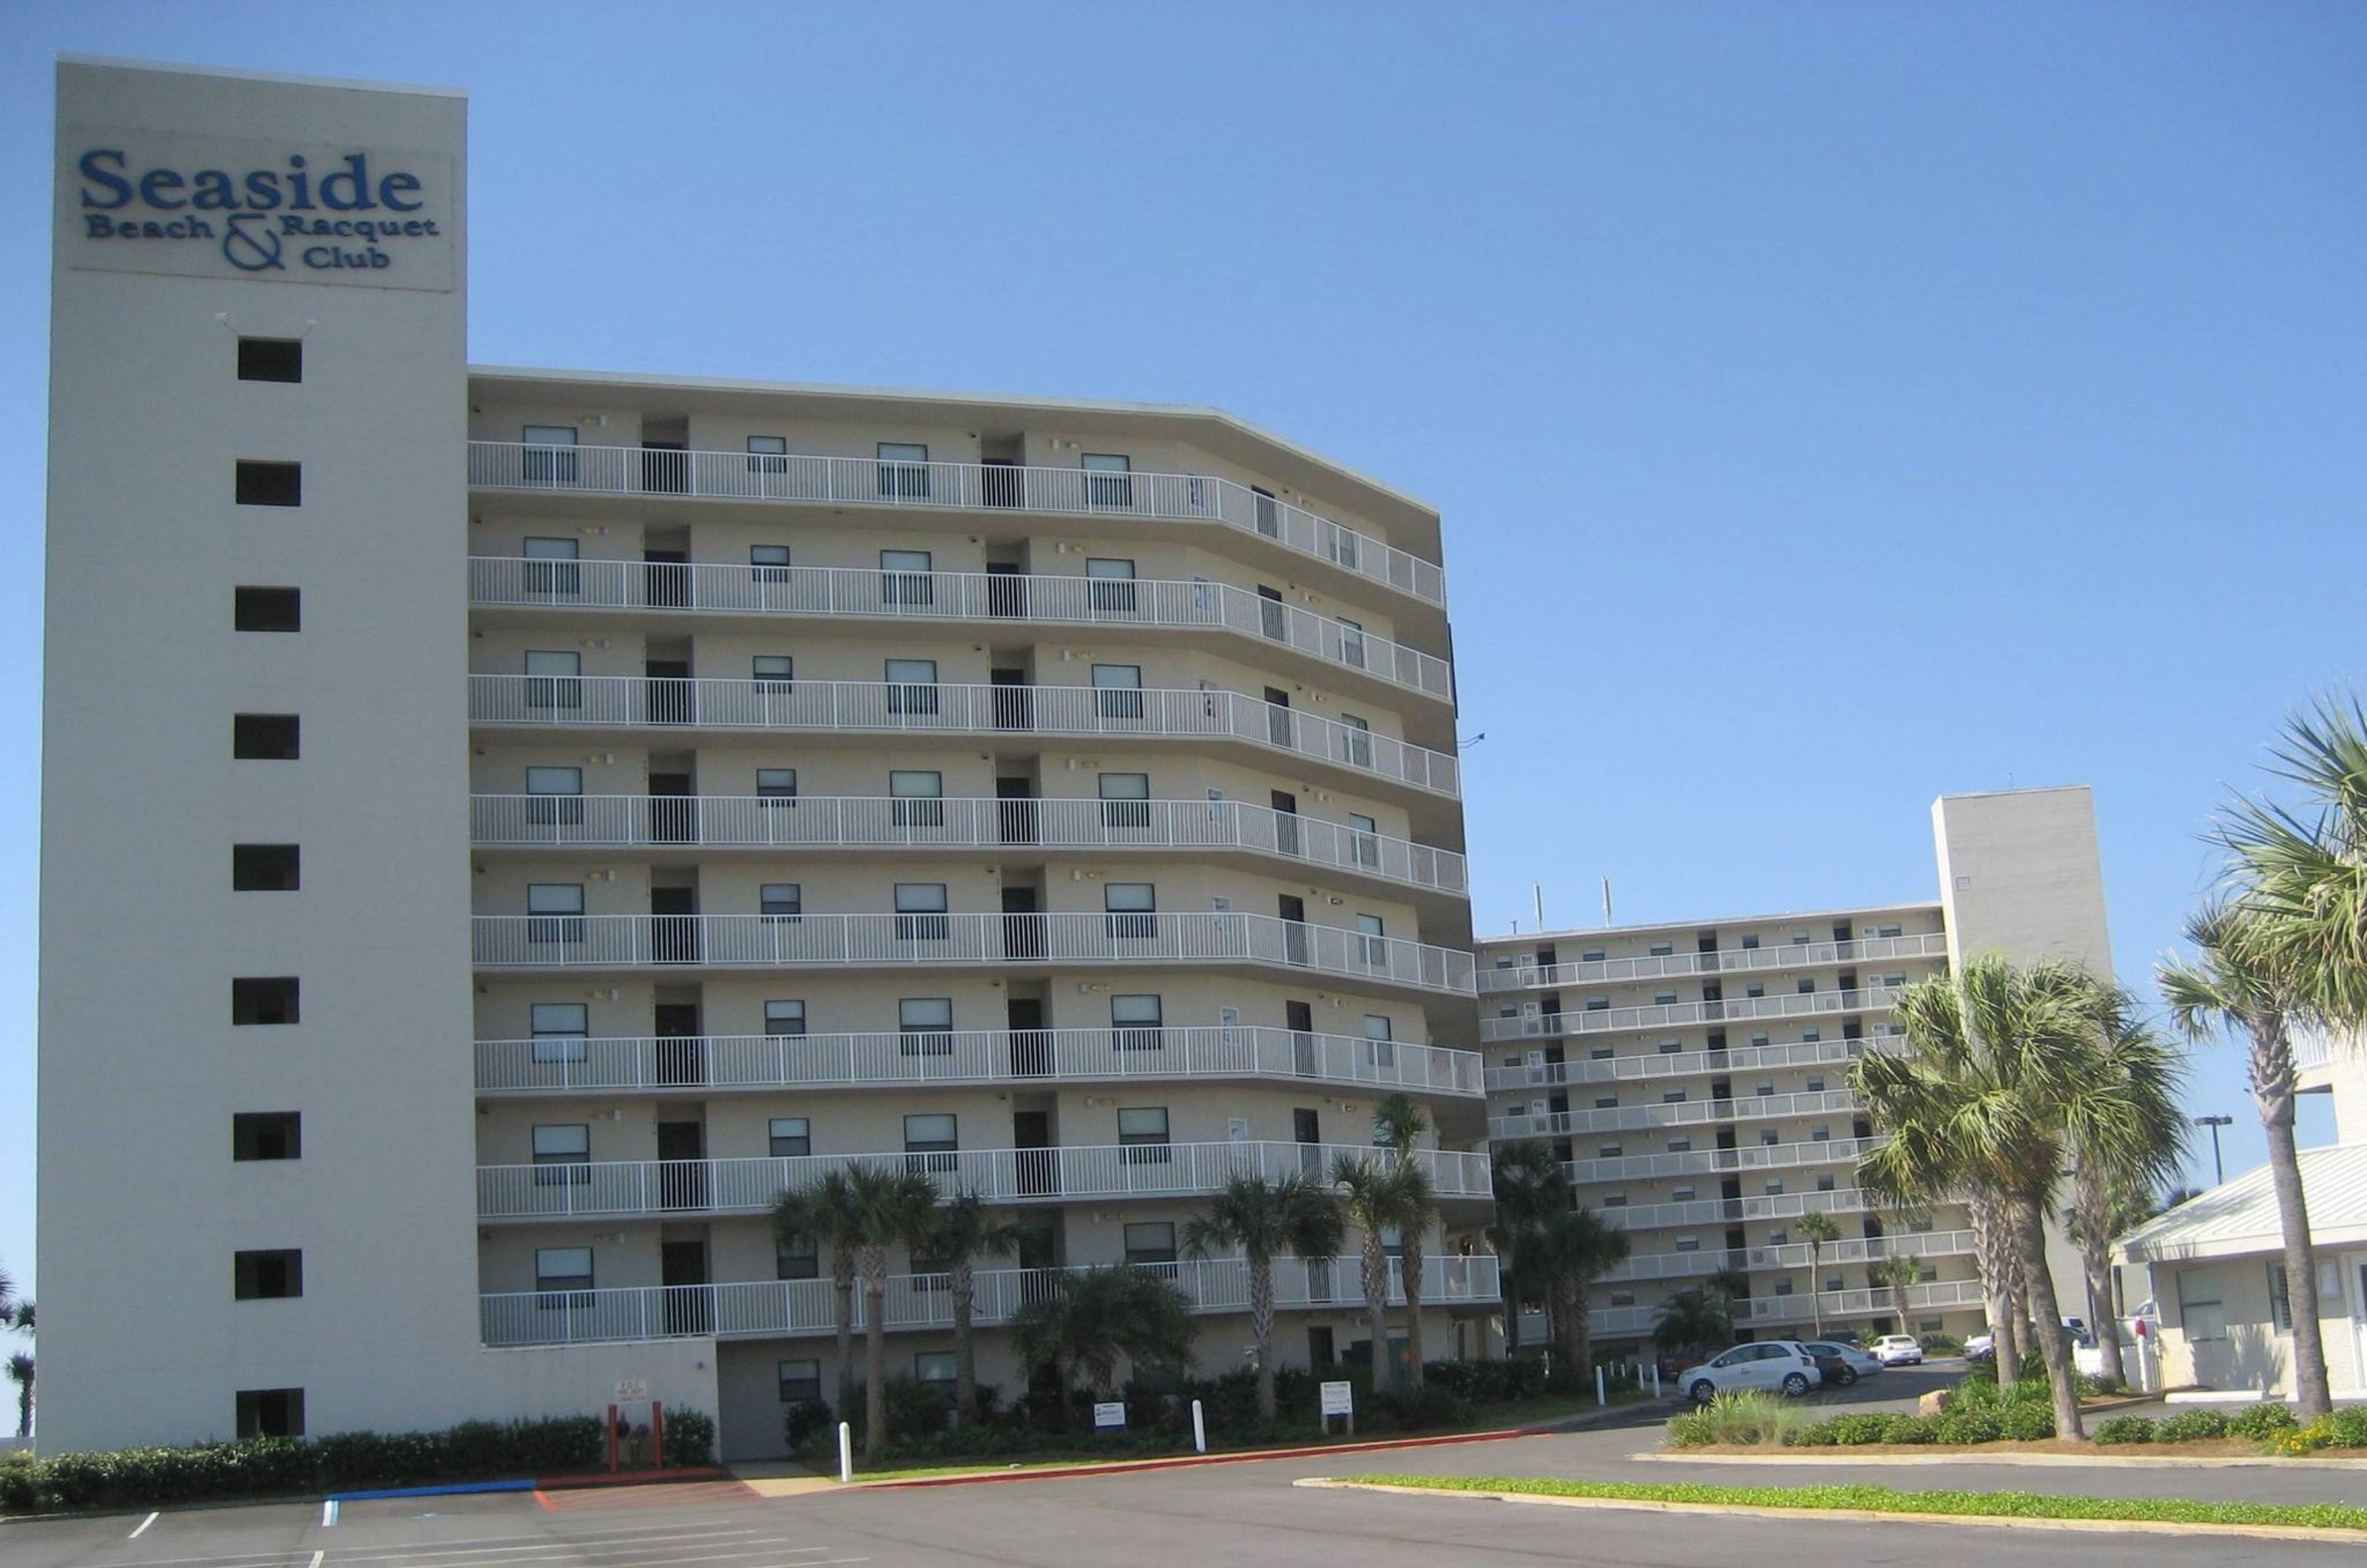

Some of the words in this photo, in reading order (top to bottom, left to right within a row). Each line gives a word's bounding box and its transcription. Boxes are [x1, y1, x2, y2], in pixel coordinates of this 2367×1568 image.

[79, 149, 425, 212] Seaside
[84, 214, 215, 239] Beach
[223, 212, 286, 271] &
[279, 214, 440, 243] Racquet
[303, 246, 391, 268] Club
